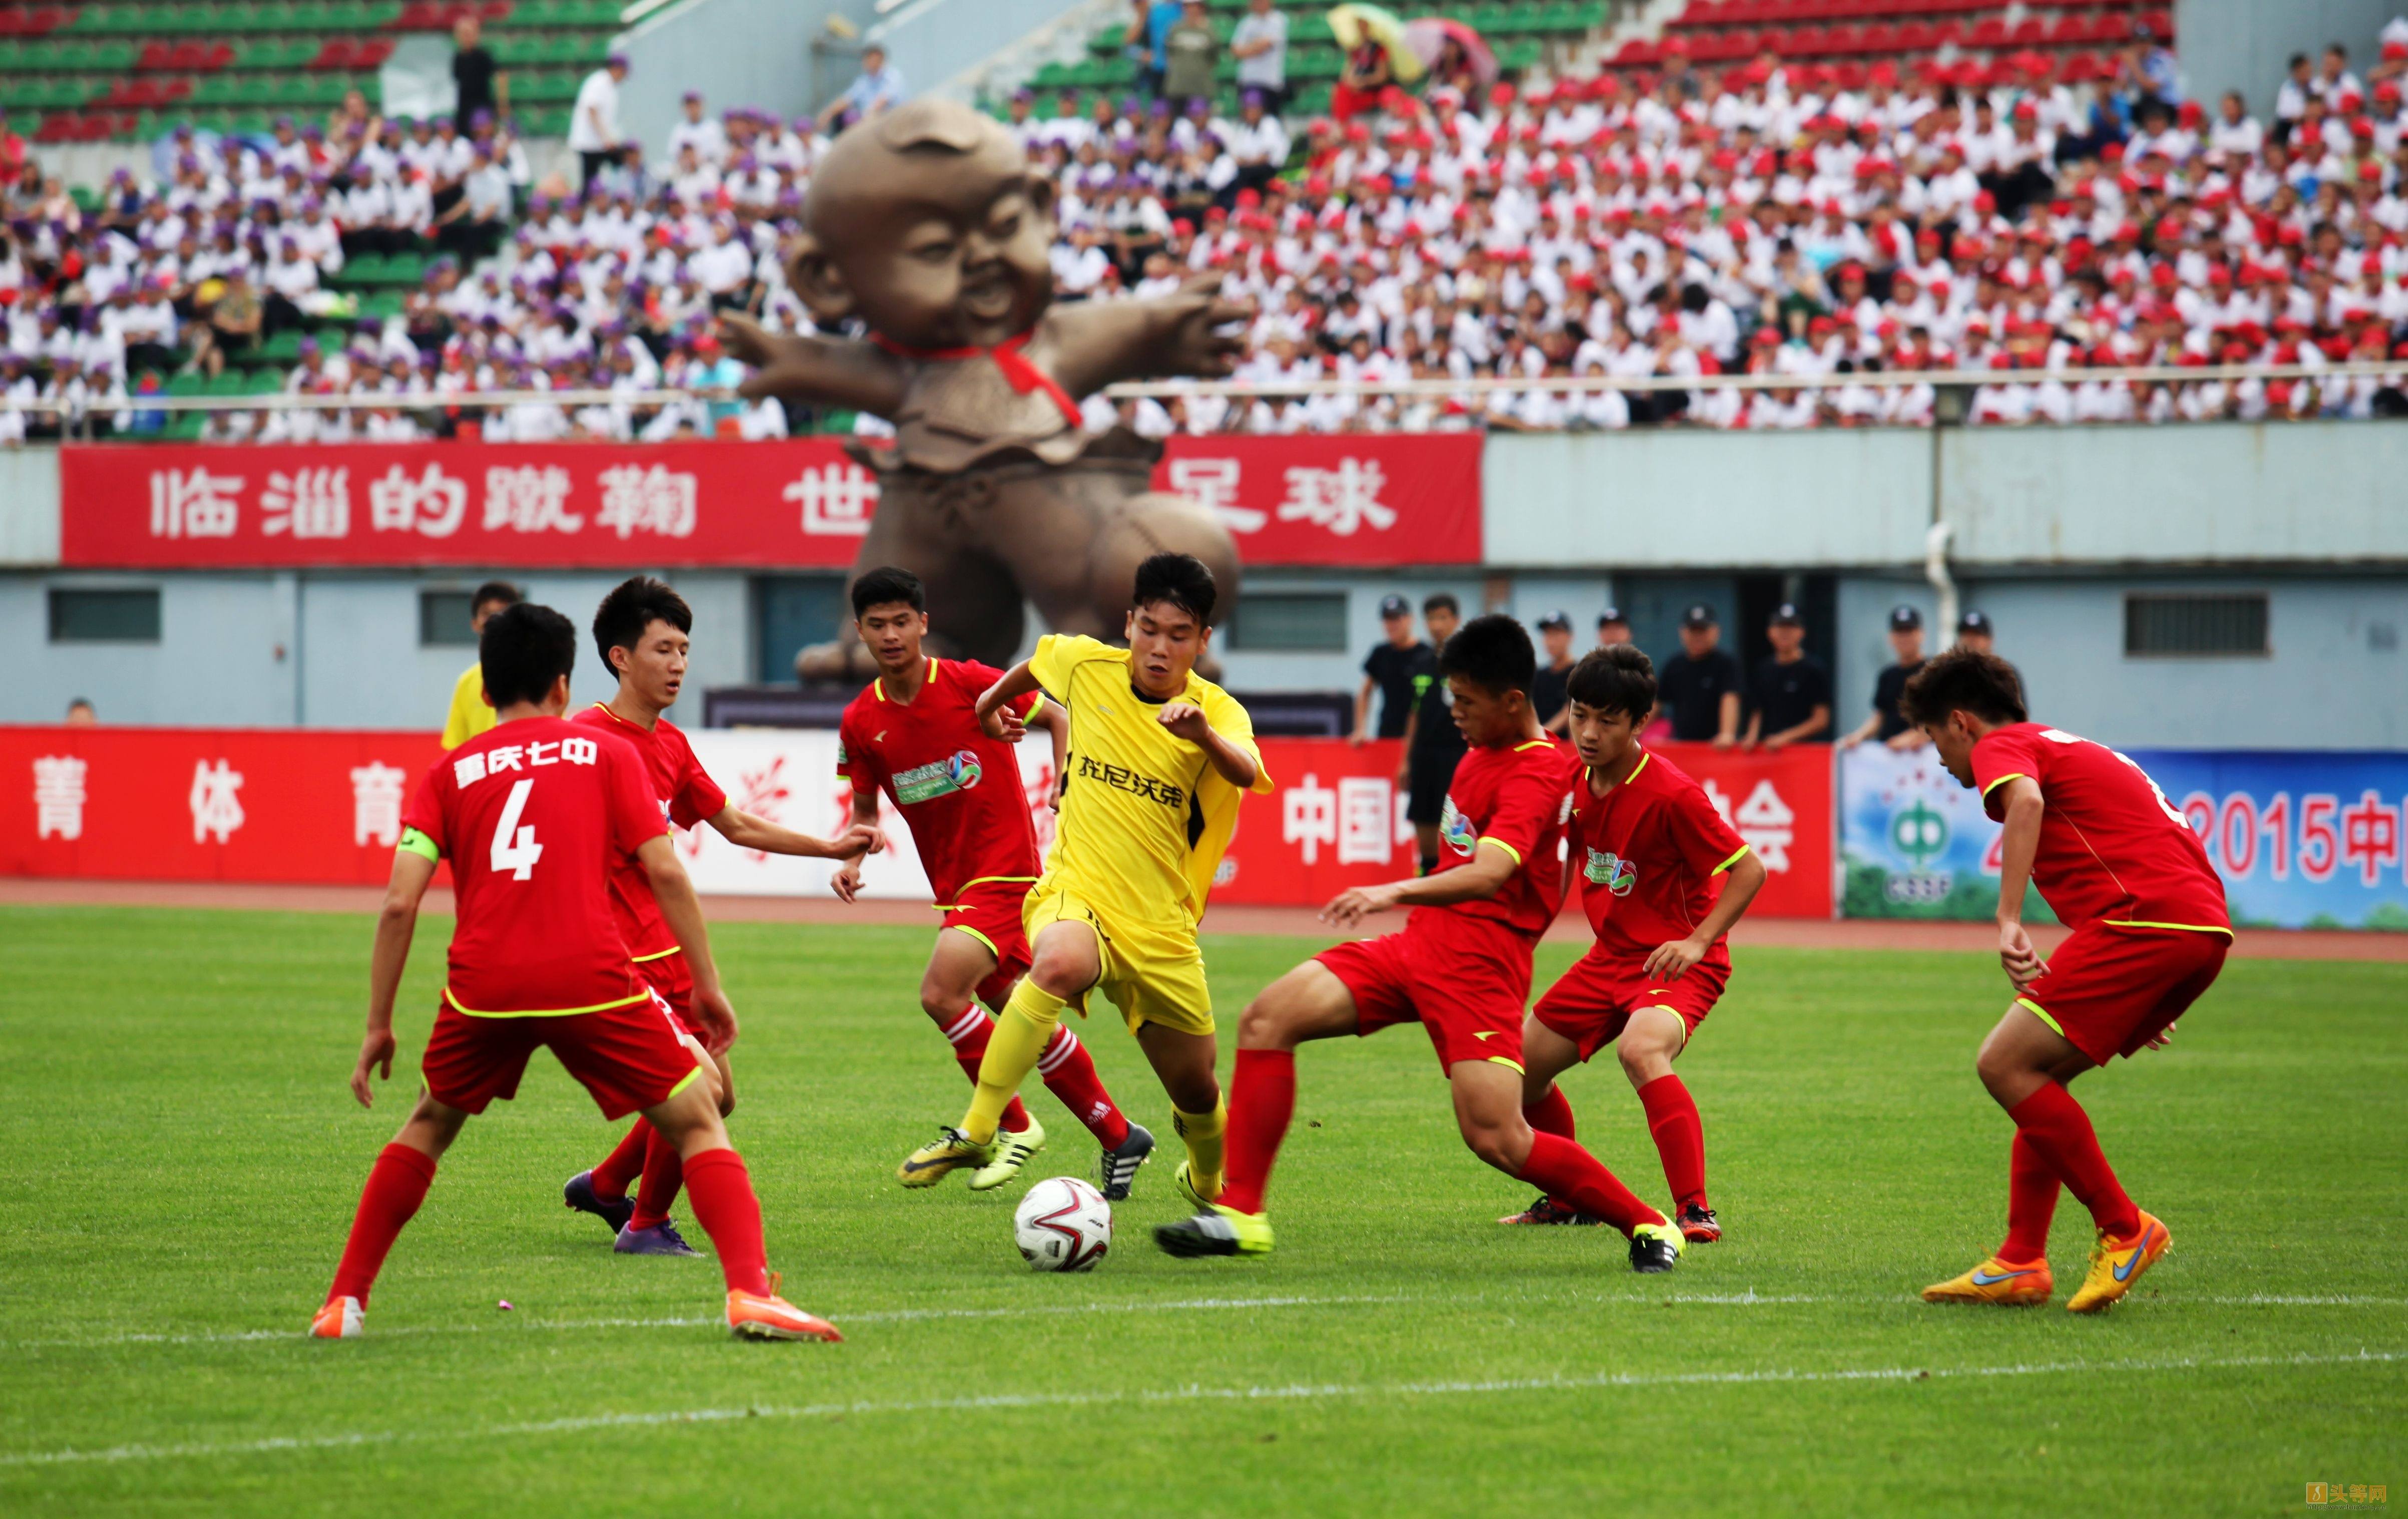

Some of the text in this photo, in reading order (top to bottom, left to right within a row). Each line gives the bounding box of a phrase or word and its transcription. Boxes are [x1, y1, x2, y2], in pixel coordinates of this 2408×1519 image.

[149, 463, 697, 539] 临淄的蹴鞠
[454, 737, 597, 790] 重庆七中
[1078, 755, 1183, 809] 托尼沃克
[490, 778, 544, 881] 4
[2180, 789, 2408, 888] 2015中
